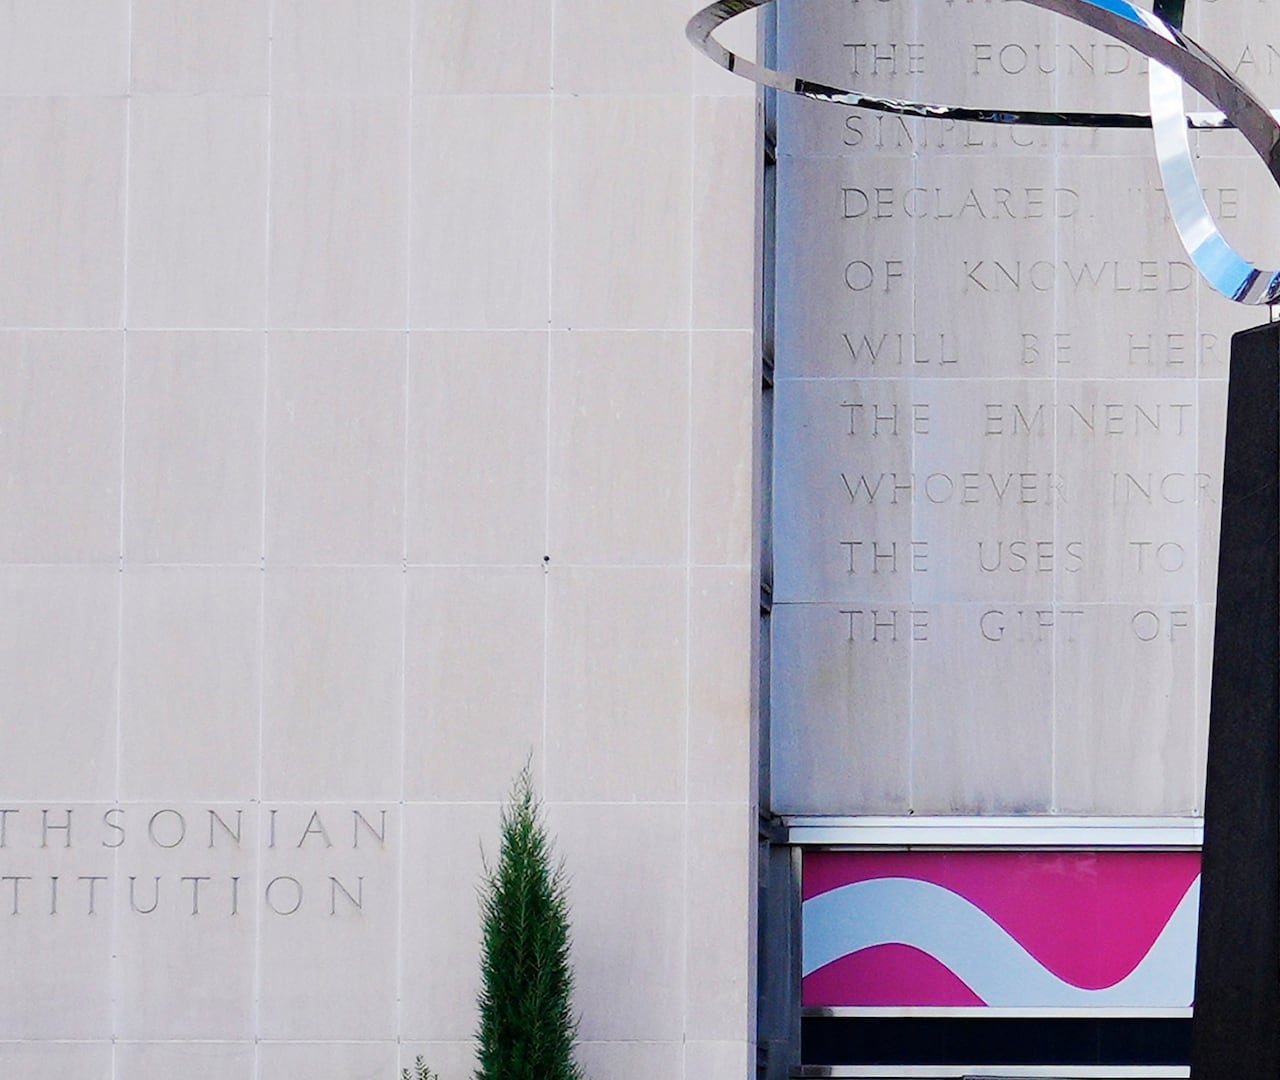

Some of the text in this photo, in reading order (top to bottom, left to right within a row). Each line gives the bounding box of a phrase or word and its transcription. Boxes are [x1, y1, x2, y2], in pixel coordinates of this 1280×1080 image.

[842, 43, 925, 76] THE
[973, 43, 1149, 76] FOUND
[844, 261, 904, 293] OF
[962, 261, 1220, 293] KNOWLED
[842, 333, 959, 365] WILL
[1021, 333, 1072, 365] BE
[839, 404, 930, 437] THE
[984, 404, 1193, 437] EMINENT
[839, 473, 1068, 505] WHOEVER
[839, 542, 929, 575] THE
[977, 542, 1084, 574] USES
[1129, 543, 1186, 575] TO
[838, 610, 929, 643] THE
[979, 610, 1084, 643] GIFT
[1130, 611, 1188, 643] OF
